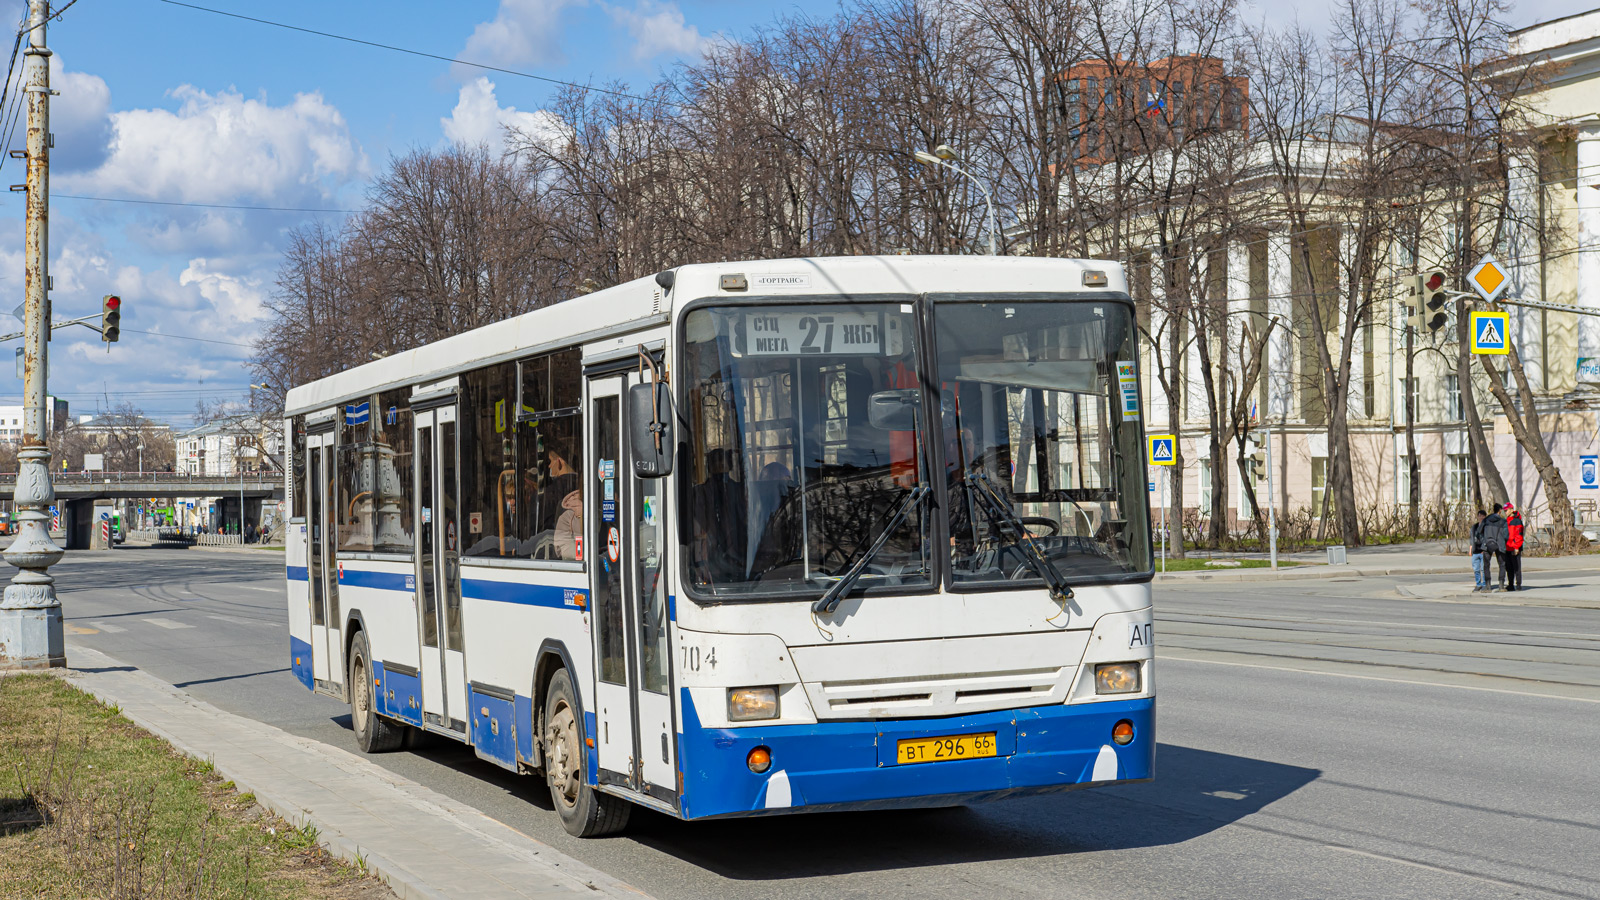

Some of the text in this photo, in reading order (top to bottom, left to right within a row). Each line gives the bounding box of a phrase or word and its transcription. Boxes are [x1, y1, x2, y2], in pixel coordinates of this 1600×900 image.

[753, 316, 779, 333] СТЦ
[798, 316, 835, 353] 27
[756, 337, 788, 352] МЕГА
[681, 646, 718, 671] 704
[933, 738, 965, 757] 296
[974, 736, 990, 749] 66
